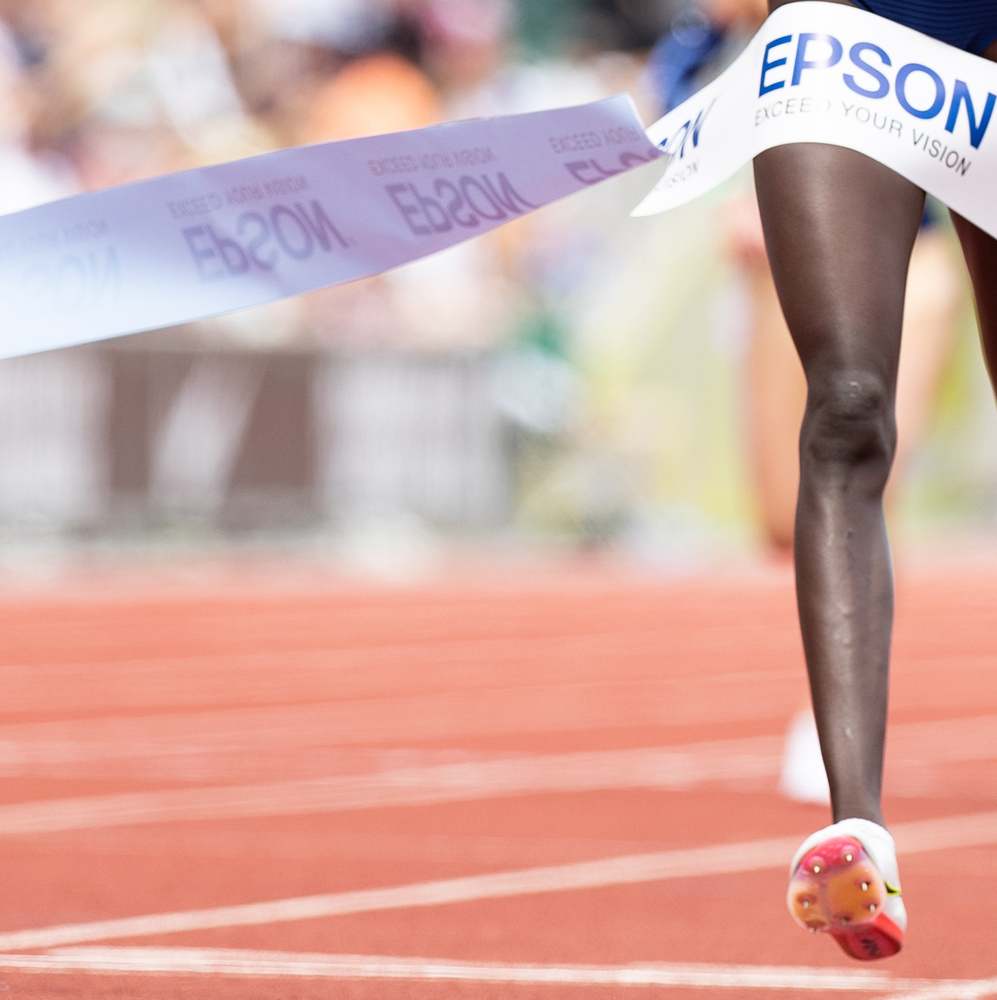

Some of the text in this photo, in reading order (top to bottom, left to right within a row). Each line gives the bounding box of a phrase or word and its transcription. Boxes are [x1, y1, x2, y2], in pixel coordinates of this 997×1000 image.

[758, 32, 997, 150] EPSON
[842, 101, 903, 138] YOUR
[912, 128, 972, 177] VISION
